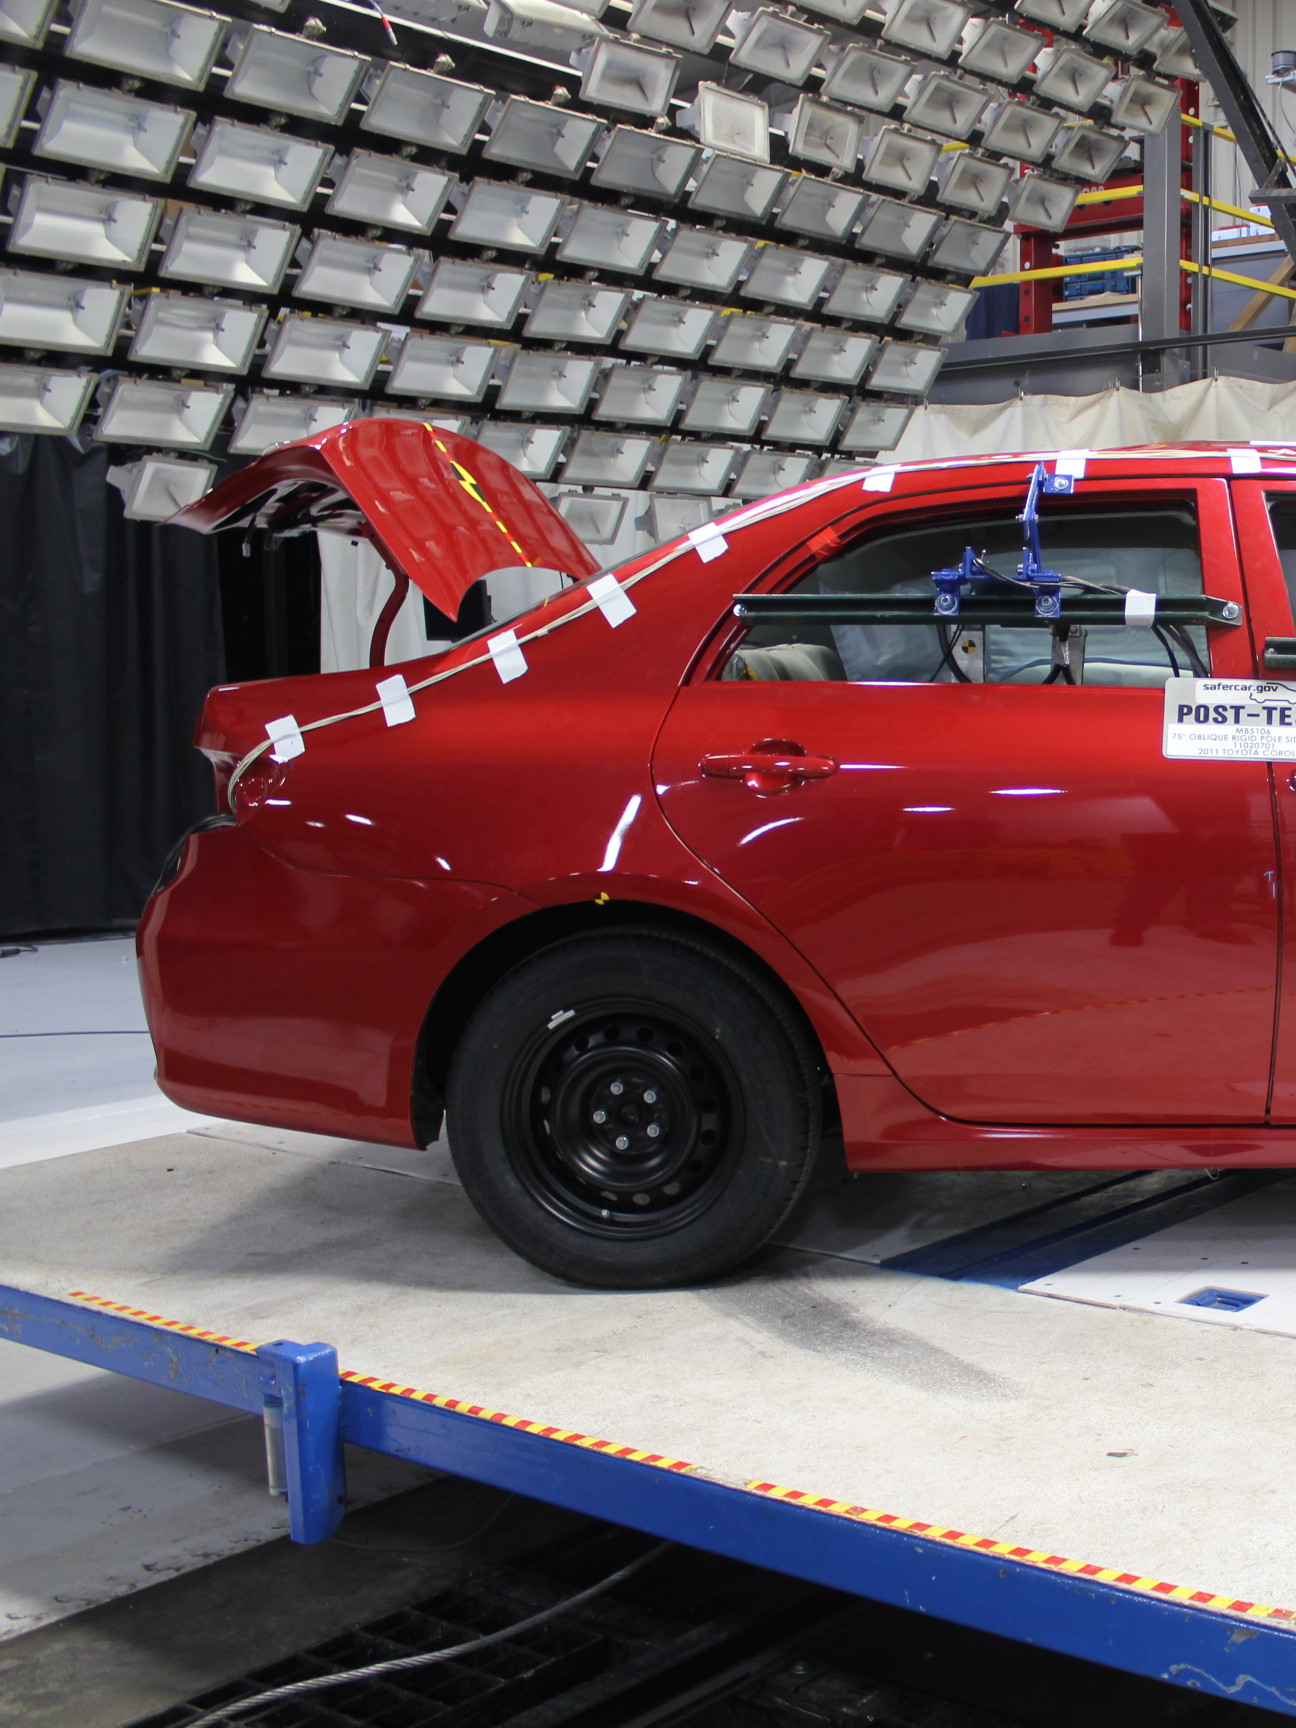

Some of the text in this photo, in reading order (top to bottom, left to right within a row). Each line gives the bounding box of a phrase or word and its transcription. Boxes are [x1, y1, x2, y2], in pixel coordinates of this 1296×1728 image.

[1202, 682, 1279, 694] safercar.gov
[1189, 733, 1229, 742] OBLIQUE
[1260, 735, 1283, 743] POLE
